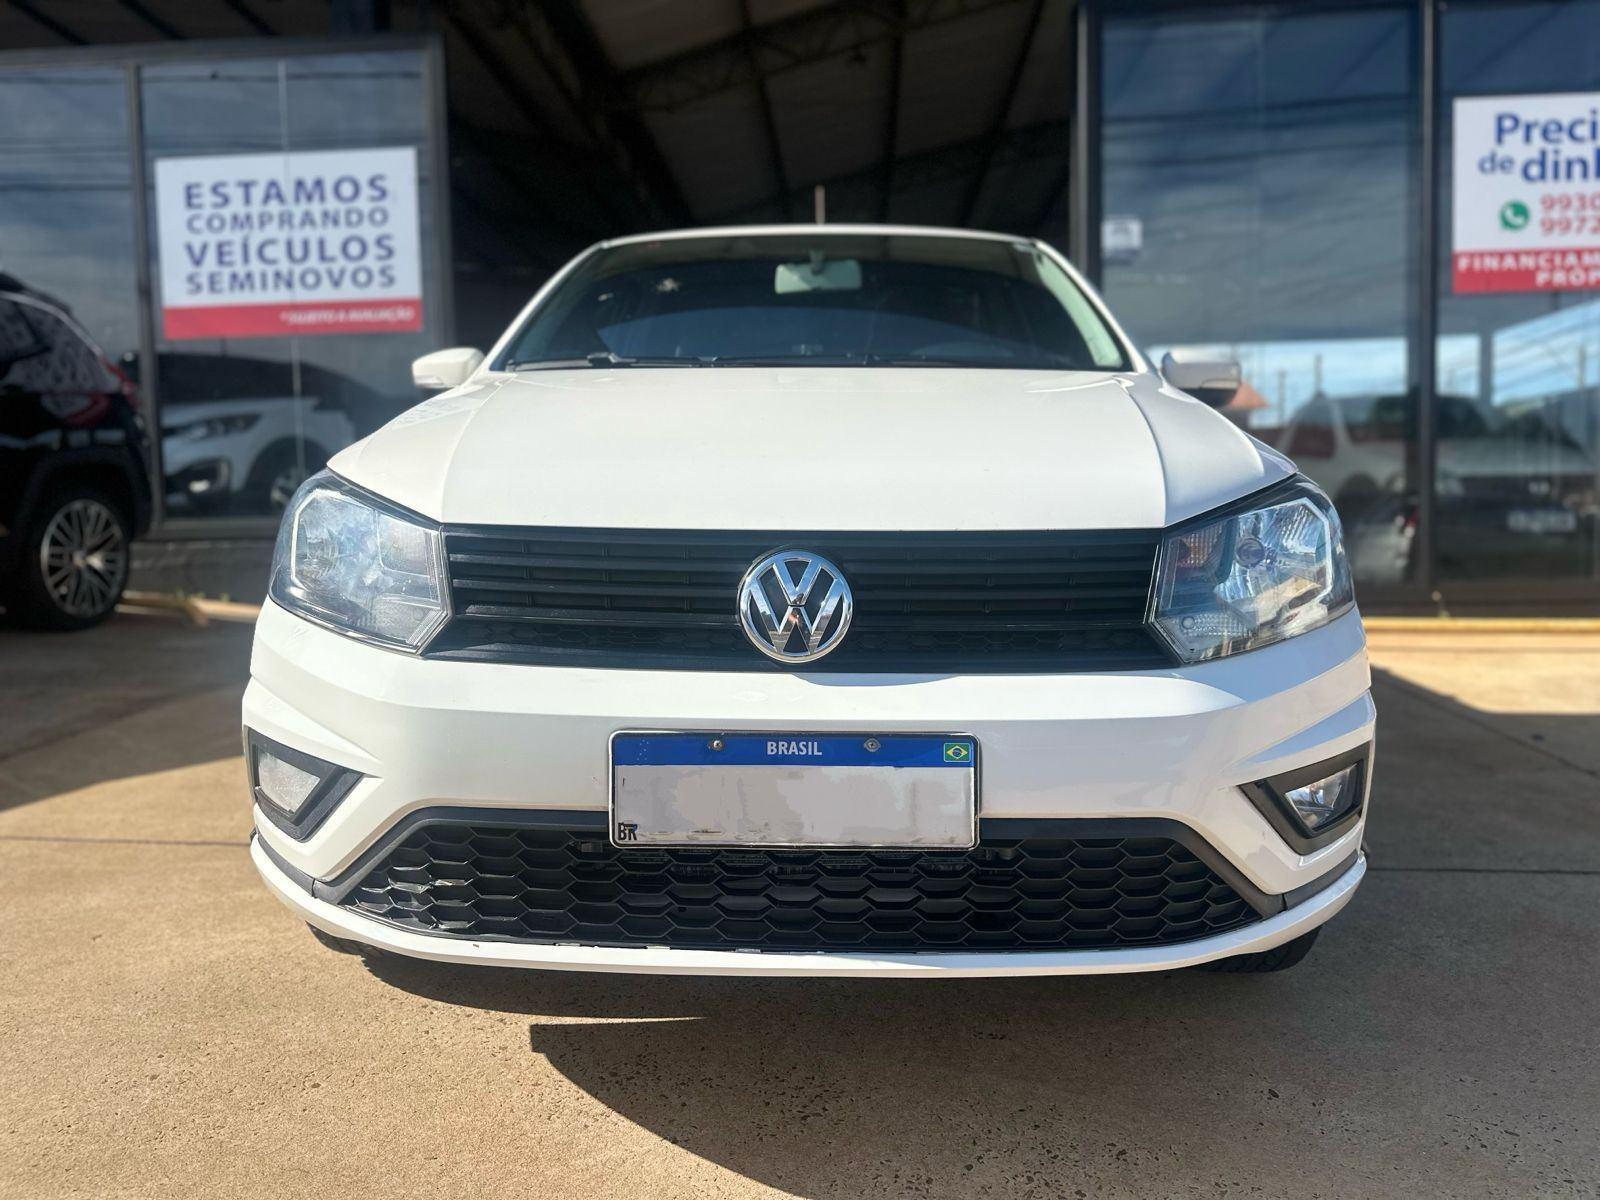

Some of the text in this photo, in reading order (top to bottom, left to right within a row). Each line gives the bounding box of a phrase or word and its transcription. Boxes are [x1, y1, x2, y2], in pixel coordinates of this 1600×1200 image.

[1496, 108, 1598, 144] Preci
[1477, 152, 1514, 174] de
[184, 174, 388, 210] ESTAMOS
[186, 207, 389, 235] COMPRANDO
[184, 234, 395, 268] VEÍCULOS
[186, 265, 395, 294] SEMINOVOS
[766, 741, 822, 756] BRASIL
[617, 822, 638, 841] BR
